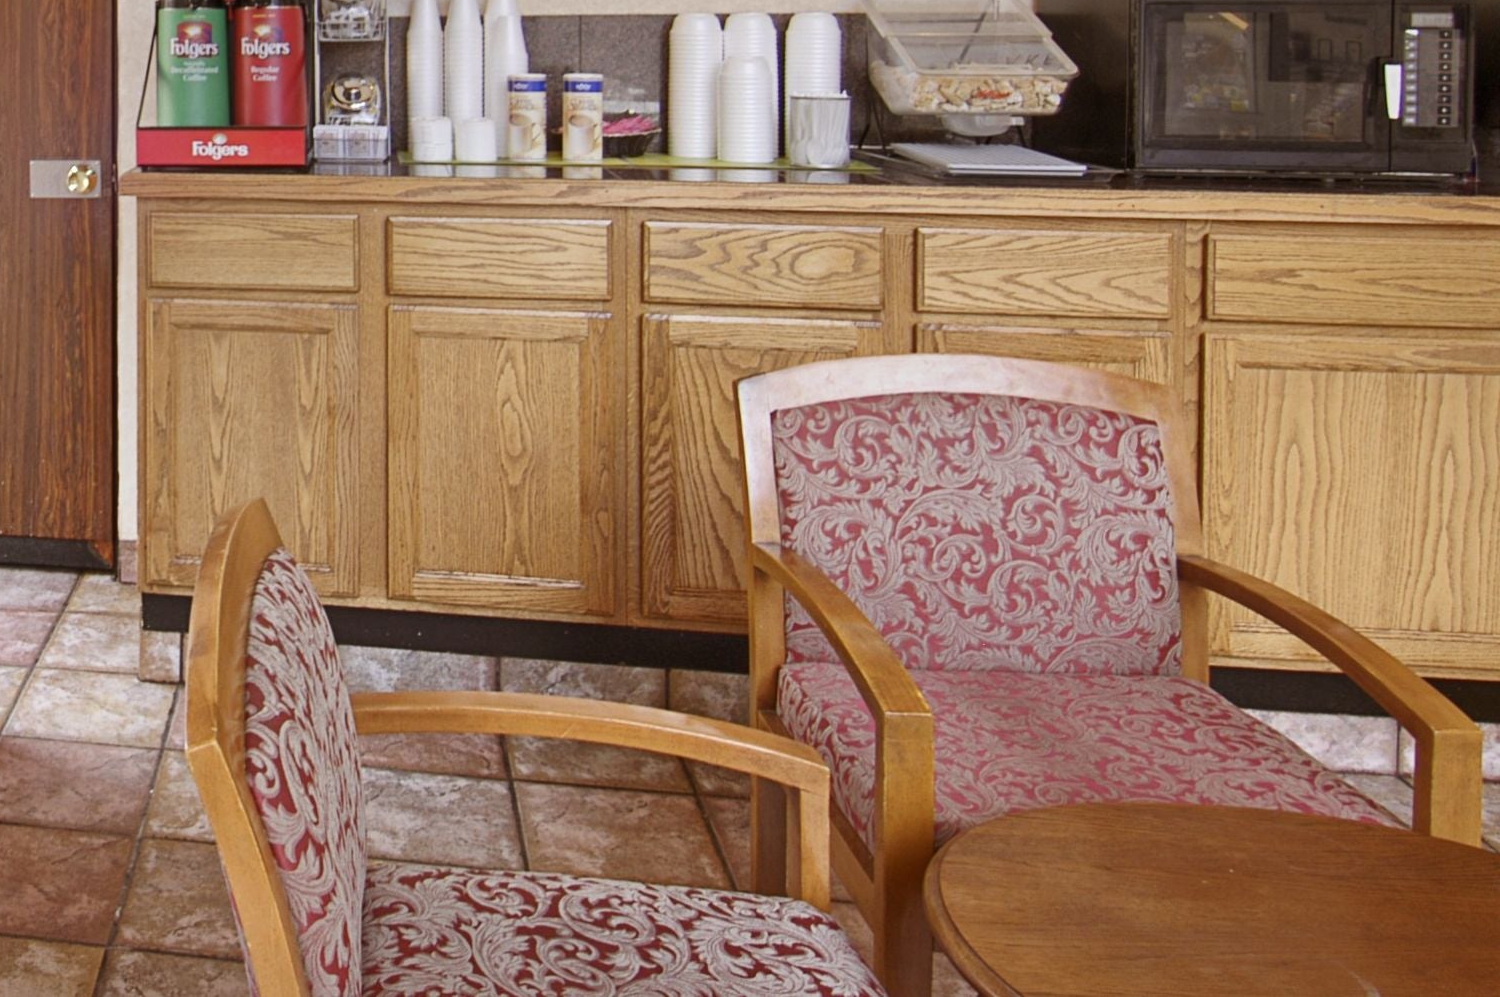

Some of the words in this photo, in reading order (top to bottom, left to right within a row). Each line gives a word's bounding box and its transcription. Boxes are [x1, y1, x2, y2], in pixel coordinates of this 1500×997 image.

[170, 37, 219, 59] Folgers
[241, 36, 291, 59] Folgers
[183, 73, 207, 82] Coffee
[251, 66, 280, 75] Regular
[253, 73, 278, 82] Coffee
[192, 140, 249, 161] Folgers
